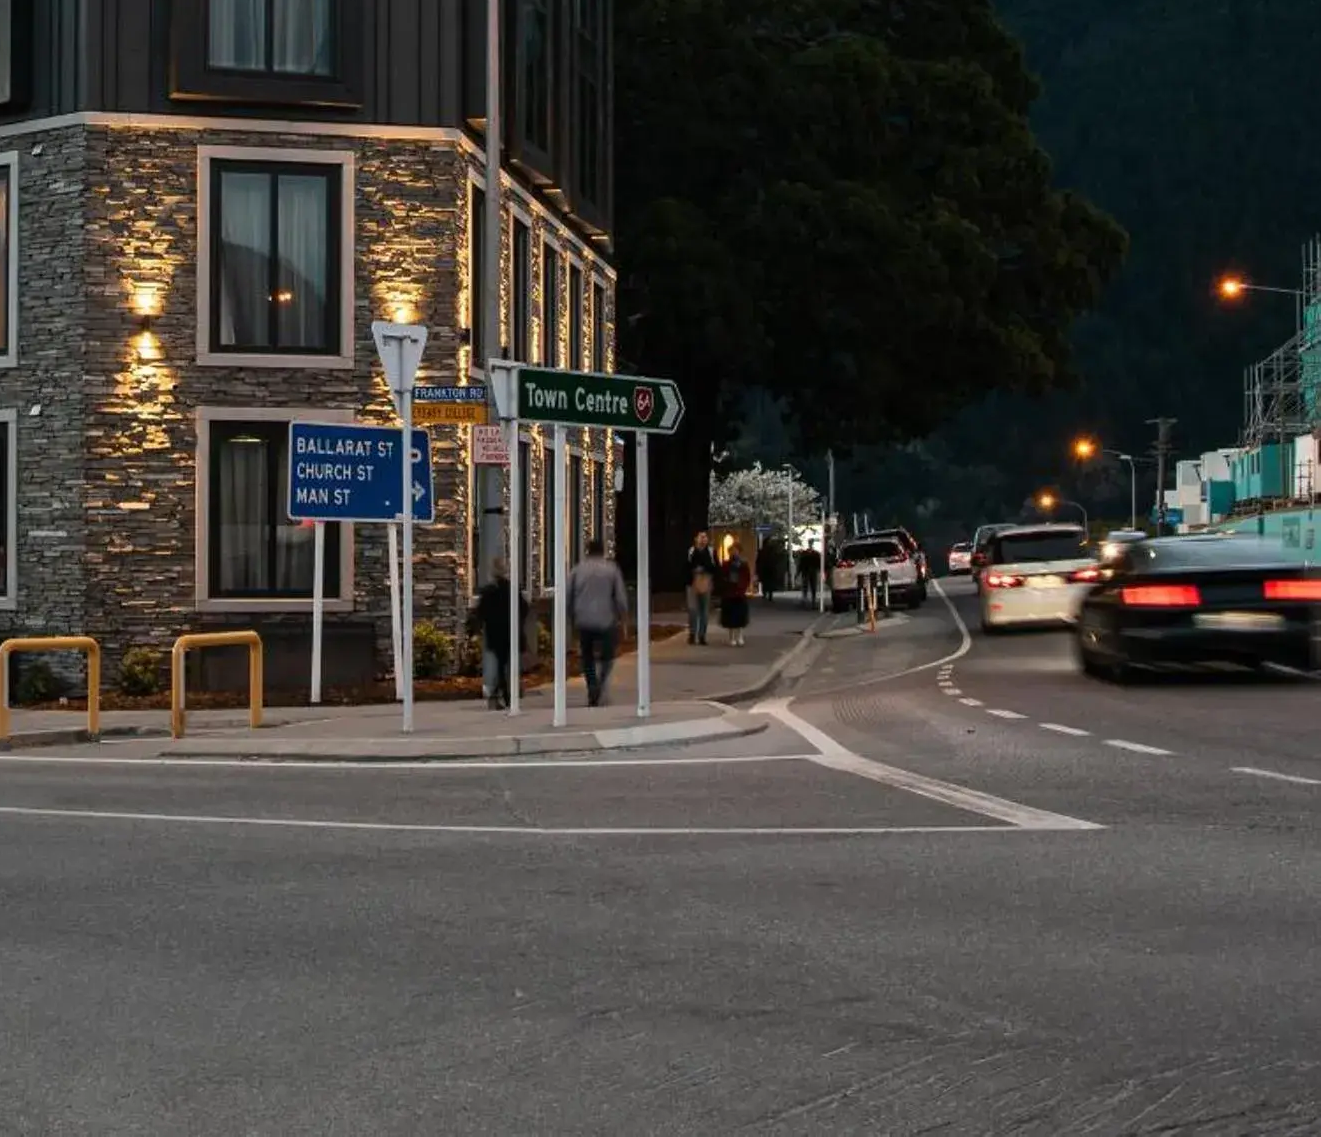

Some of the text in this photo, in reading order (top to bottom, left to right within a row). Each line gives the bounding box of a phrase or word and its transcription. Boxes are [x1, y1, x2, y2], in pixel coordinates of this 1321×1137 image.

[525, 382, 568, 409] Town
[575, 386, 628, 414] Centre
[296, 437, 372, 456] BALLARAT
[378, 441, 394, 458] ST
[296, 462, 374, 481] CHURCH ST
[296, 487, 351, 505] MAN ST
